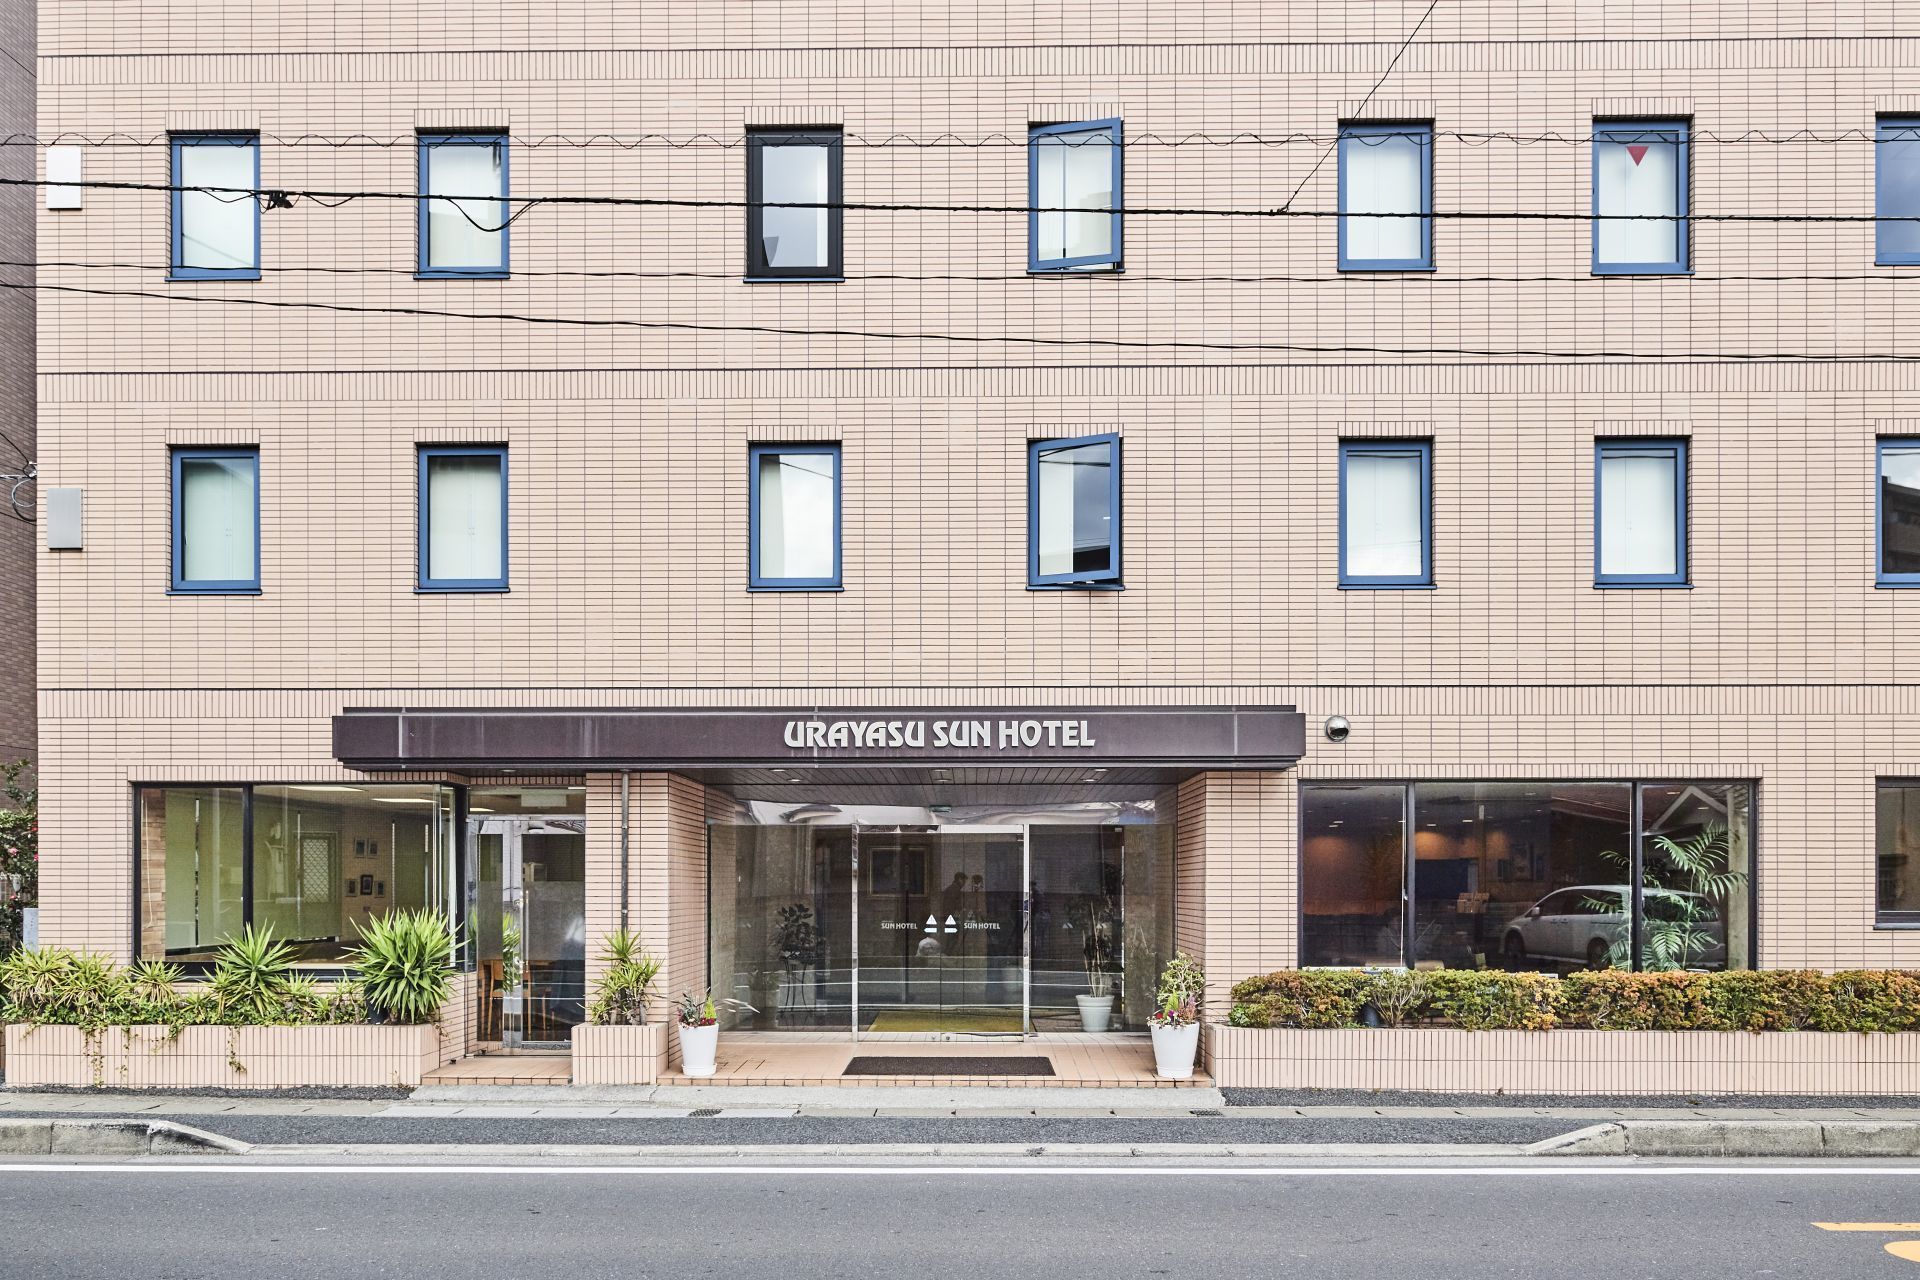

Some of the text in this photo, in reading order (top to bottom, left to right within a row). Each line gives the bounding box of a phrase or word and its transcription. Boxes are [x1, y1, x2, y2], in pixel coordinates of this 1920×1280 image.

[784, 720, 1096, 750] URAYASU SUN HOTEL
[881, 922, 918, 930] SUN HOTEL
[963, 922, 1001, 930] SUN HOTEL
